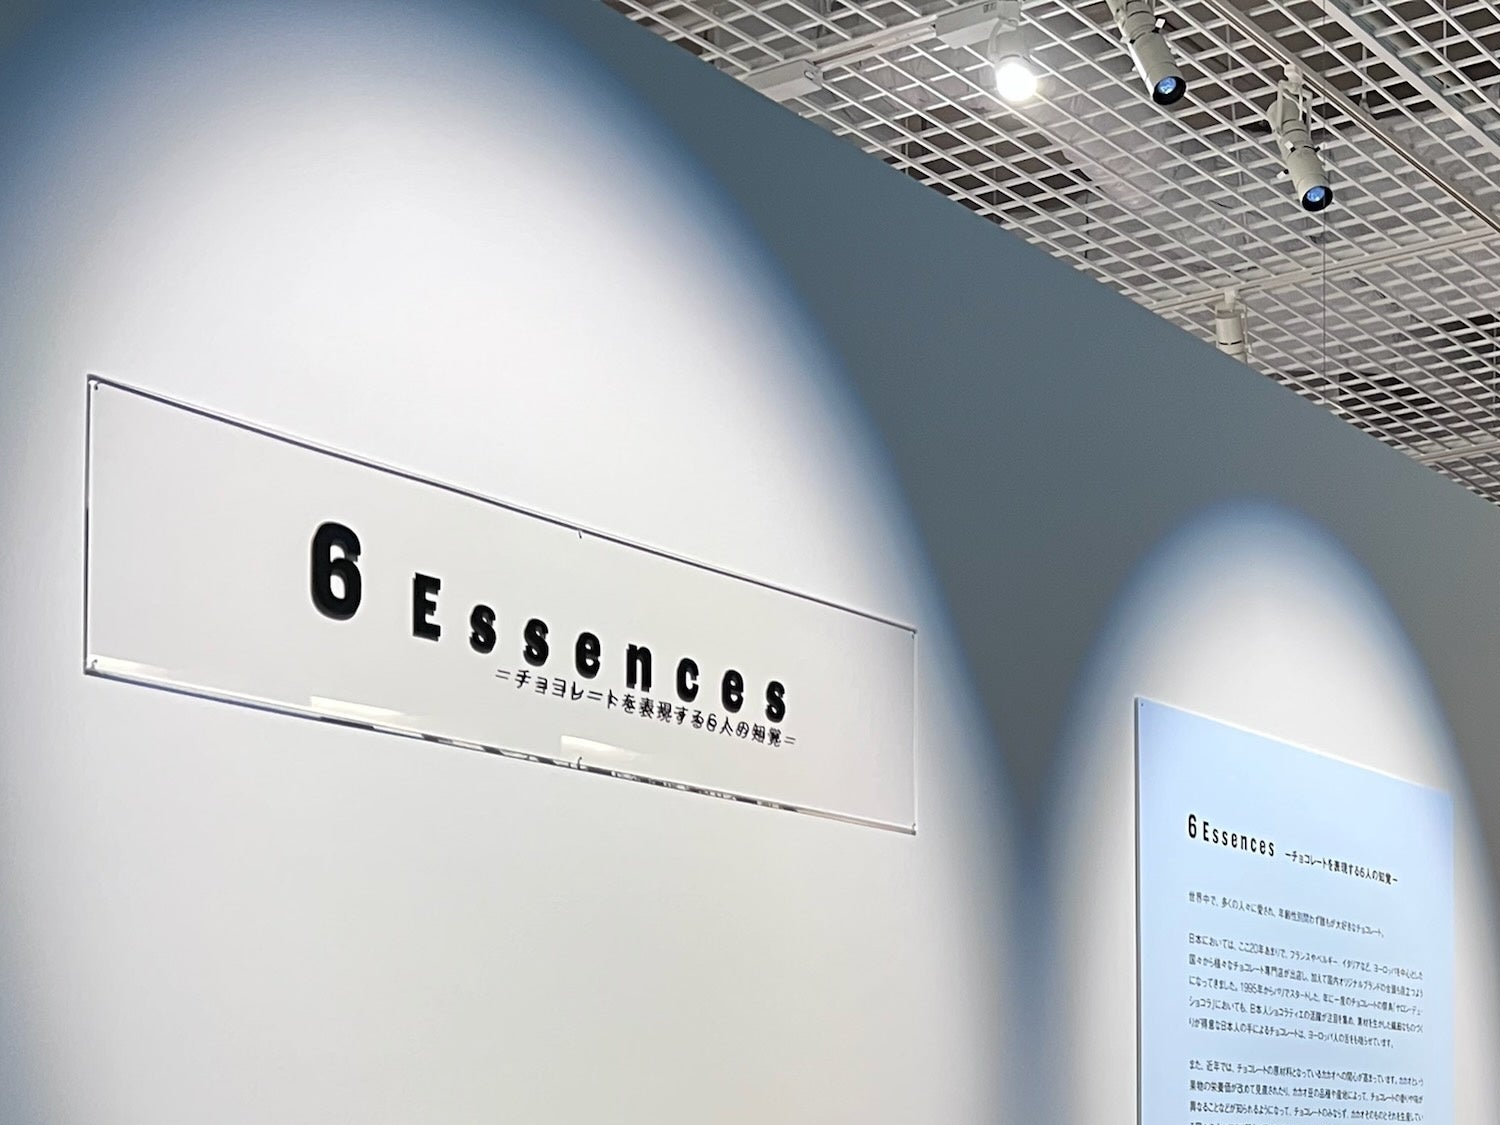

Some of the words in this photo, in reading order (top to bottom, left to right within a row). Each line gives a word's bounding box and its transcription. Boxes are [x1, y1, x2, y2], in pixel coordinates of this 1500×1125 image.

[309, 521, 362, 621] 6
[411, 572, 787, 723] Essences
[1188, 813, 1197, 839] 6
[1202, 820, 1275, 858] Essences
